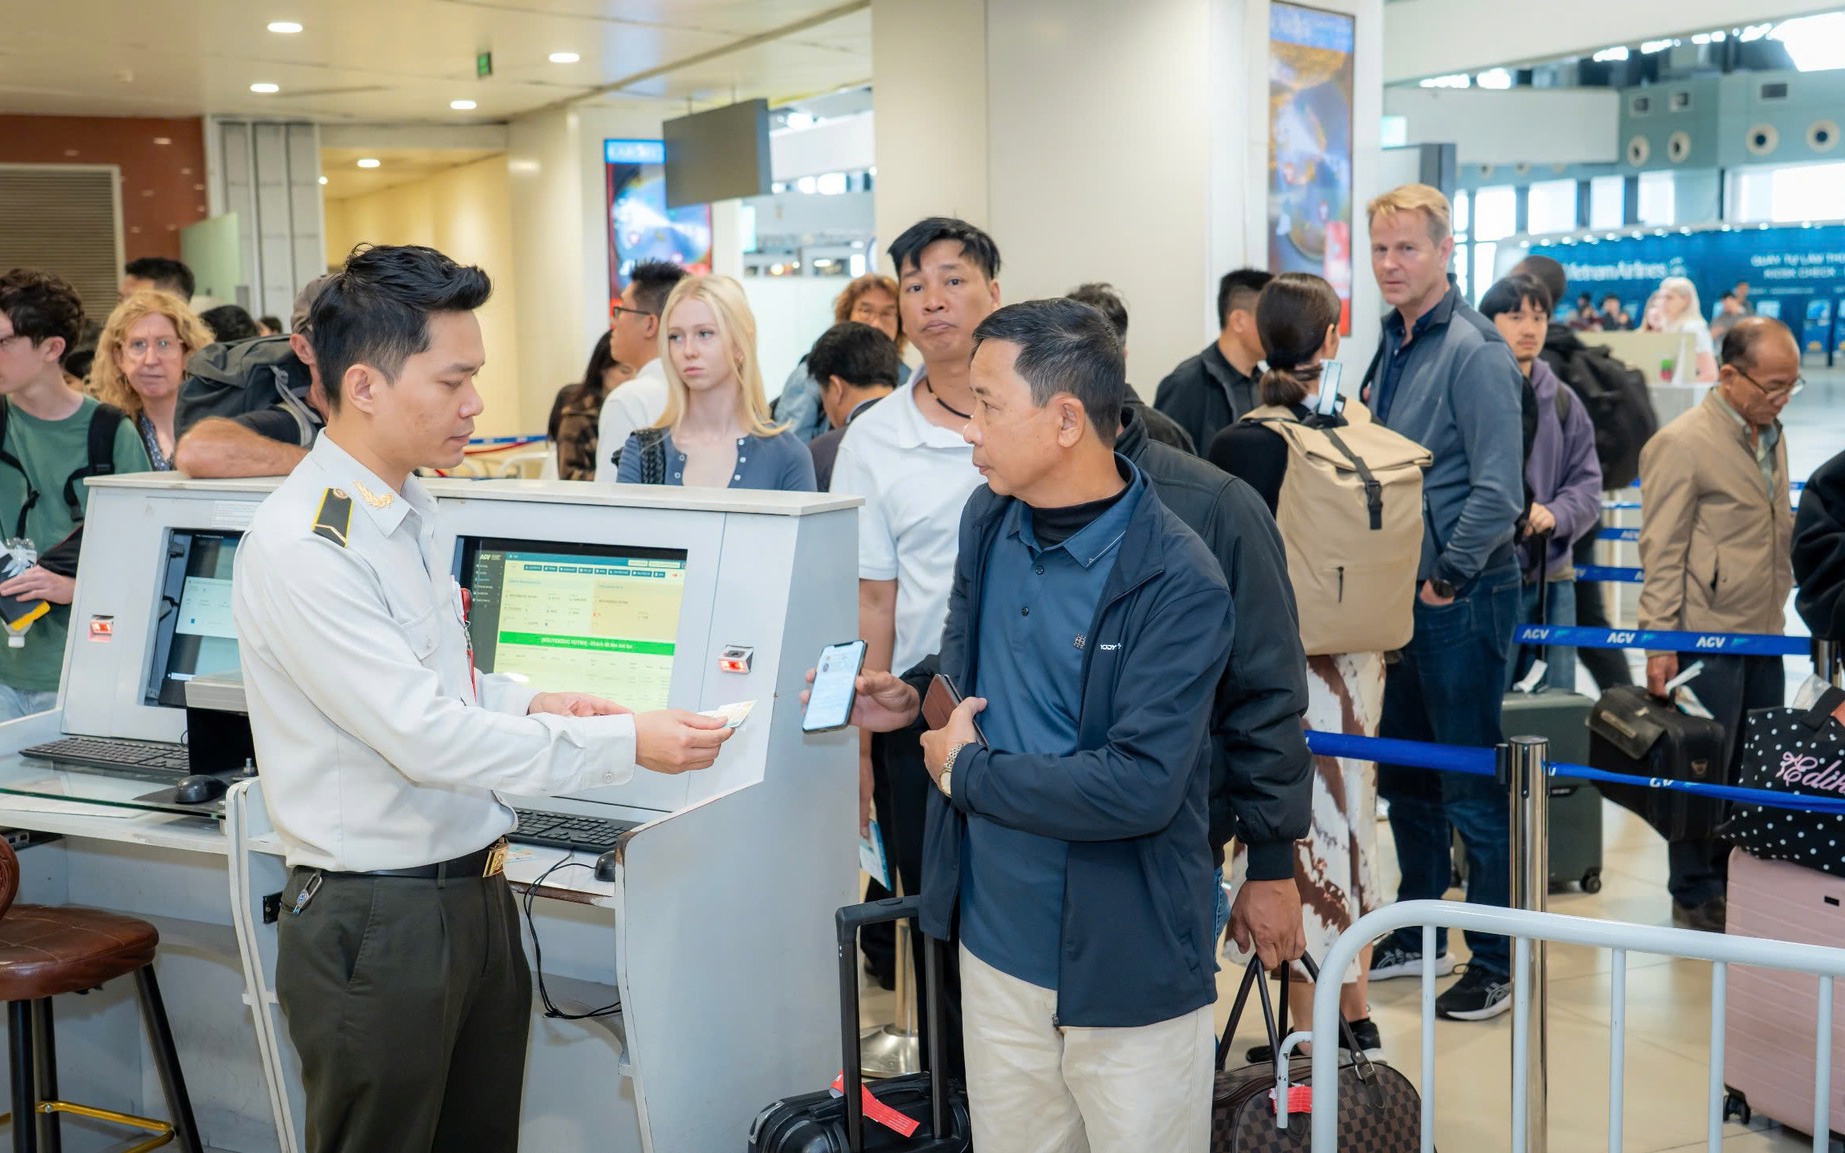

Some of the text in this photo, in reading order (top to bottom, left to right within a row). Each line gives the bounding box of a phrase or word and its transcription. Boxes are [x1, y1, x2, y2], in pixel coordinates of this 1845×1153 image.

[1522, 628, 1726, 648] ACV ACV ACV
